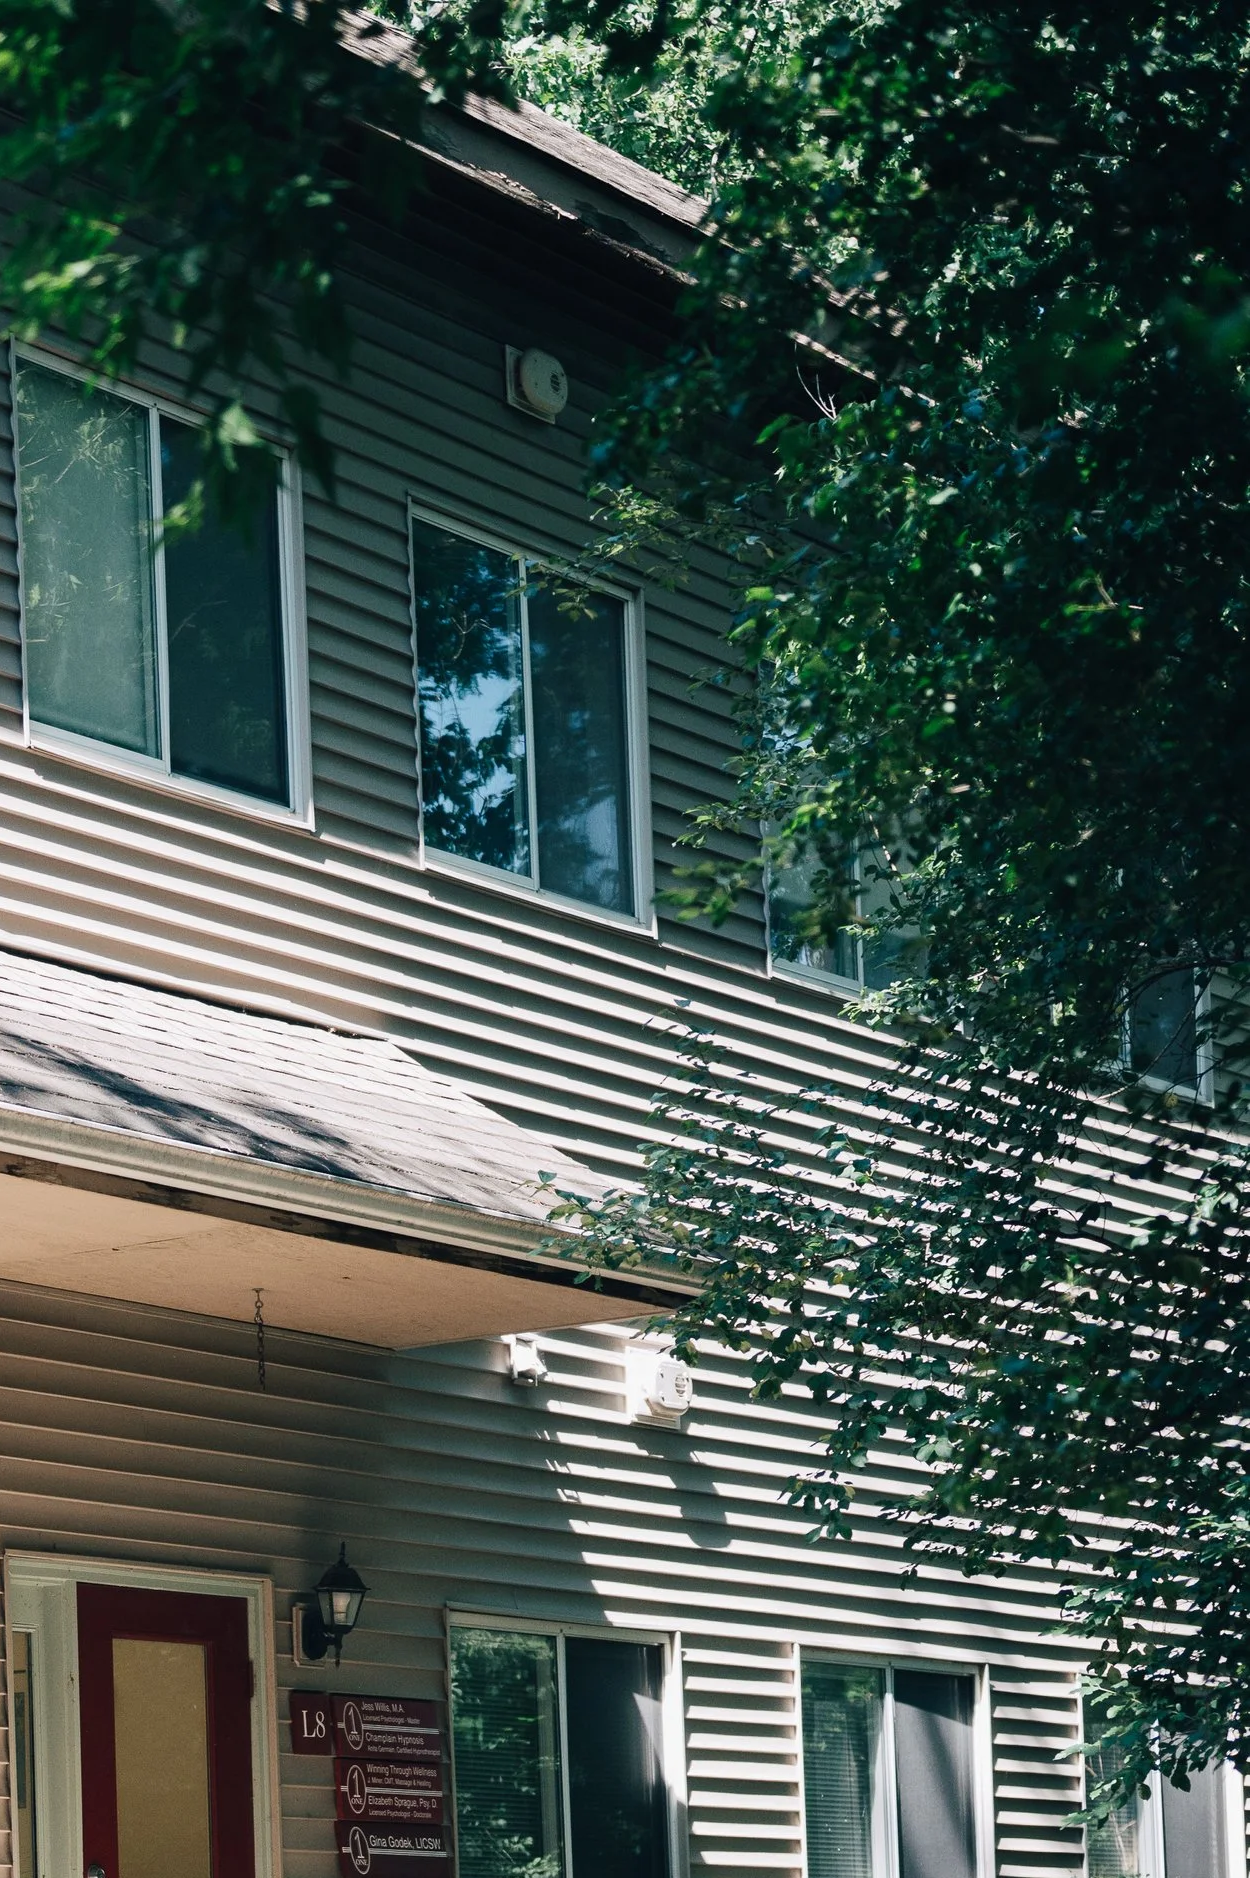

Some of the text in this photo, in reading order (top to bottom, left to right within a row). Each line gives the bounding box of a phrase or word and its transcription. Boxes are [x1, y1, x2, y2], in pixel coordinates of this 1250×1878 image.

[361, 1701, 374, 1711] Jess
[374, 1702, 392, 1713] Willis,
[301, 1709, 326, 1739] L8
[365, 1732, 425, 1746] Champlain Hypnosis
[366, 1763, 438, 1777] Winning Through Wellness
[368, 1795, 393, 1806] Elizabeth
[394, 1796, 419, 1809] Sprague,
[419, 1798, 431, 1810] Psy.
[369, 1834, 441, 1850] Gina Godek, LICSW
